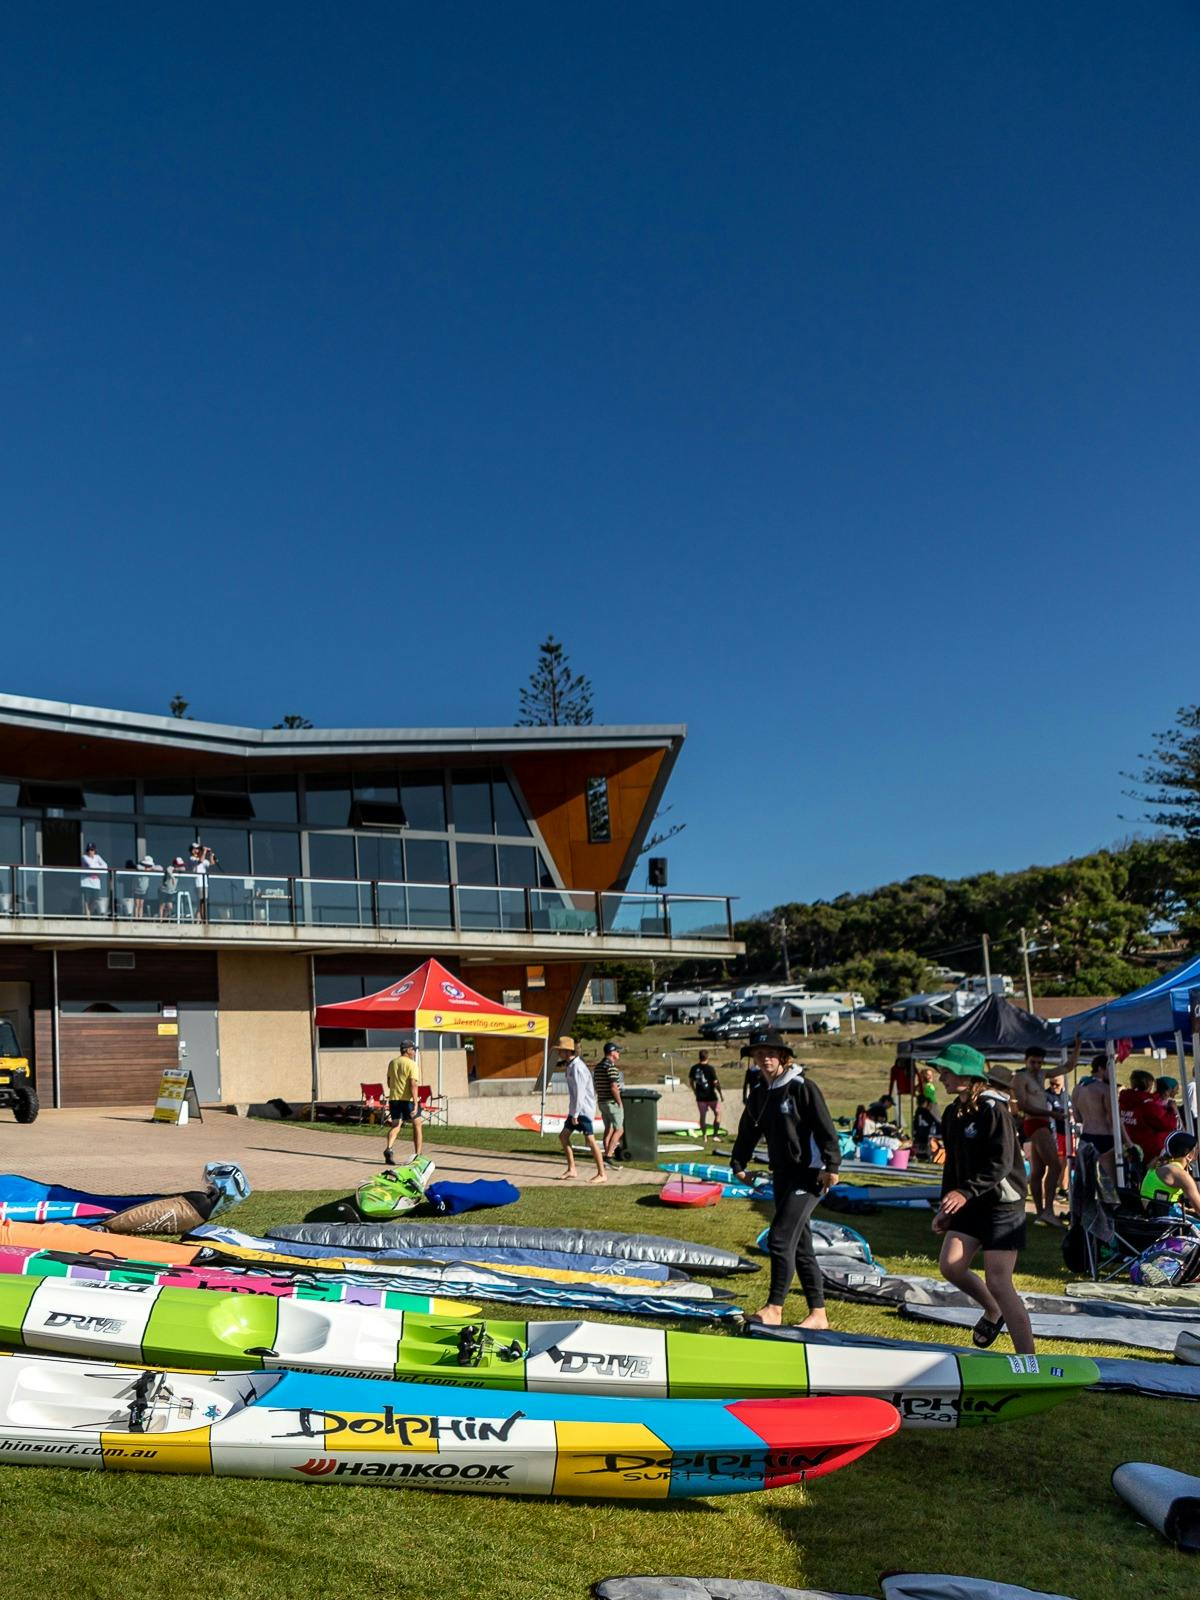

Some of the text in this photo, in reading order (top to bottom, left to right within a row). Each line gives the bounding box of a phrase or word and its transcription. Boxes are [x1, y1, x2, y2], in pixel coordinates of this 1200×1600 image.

[43, 1310, 128, 1334] DRIVE
[560, 1350, 653, 1379] DRIVE
[366, 1476, 511, 1488] driving emotion
